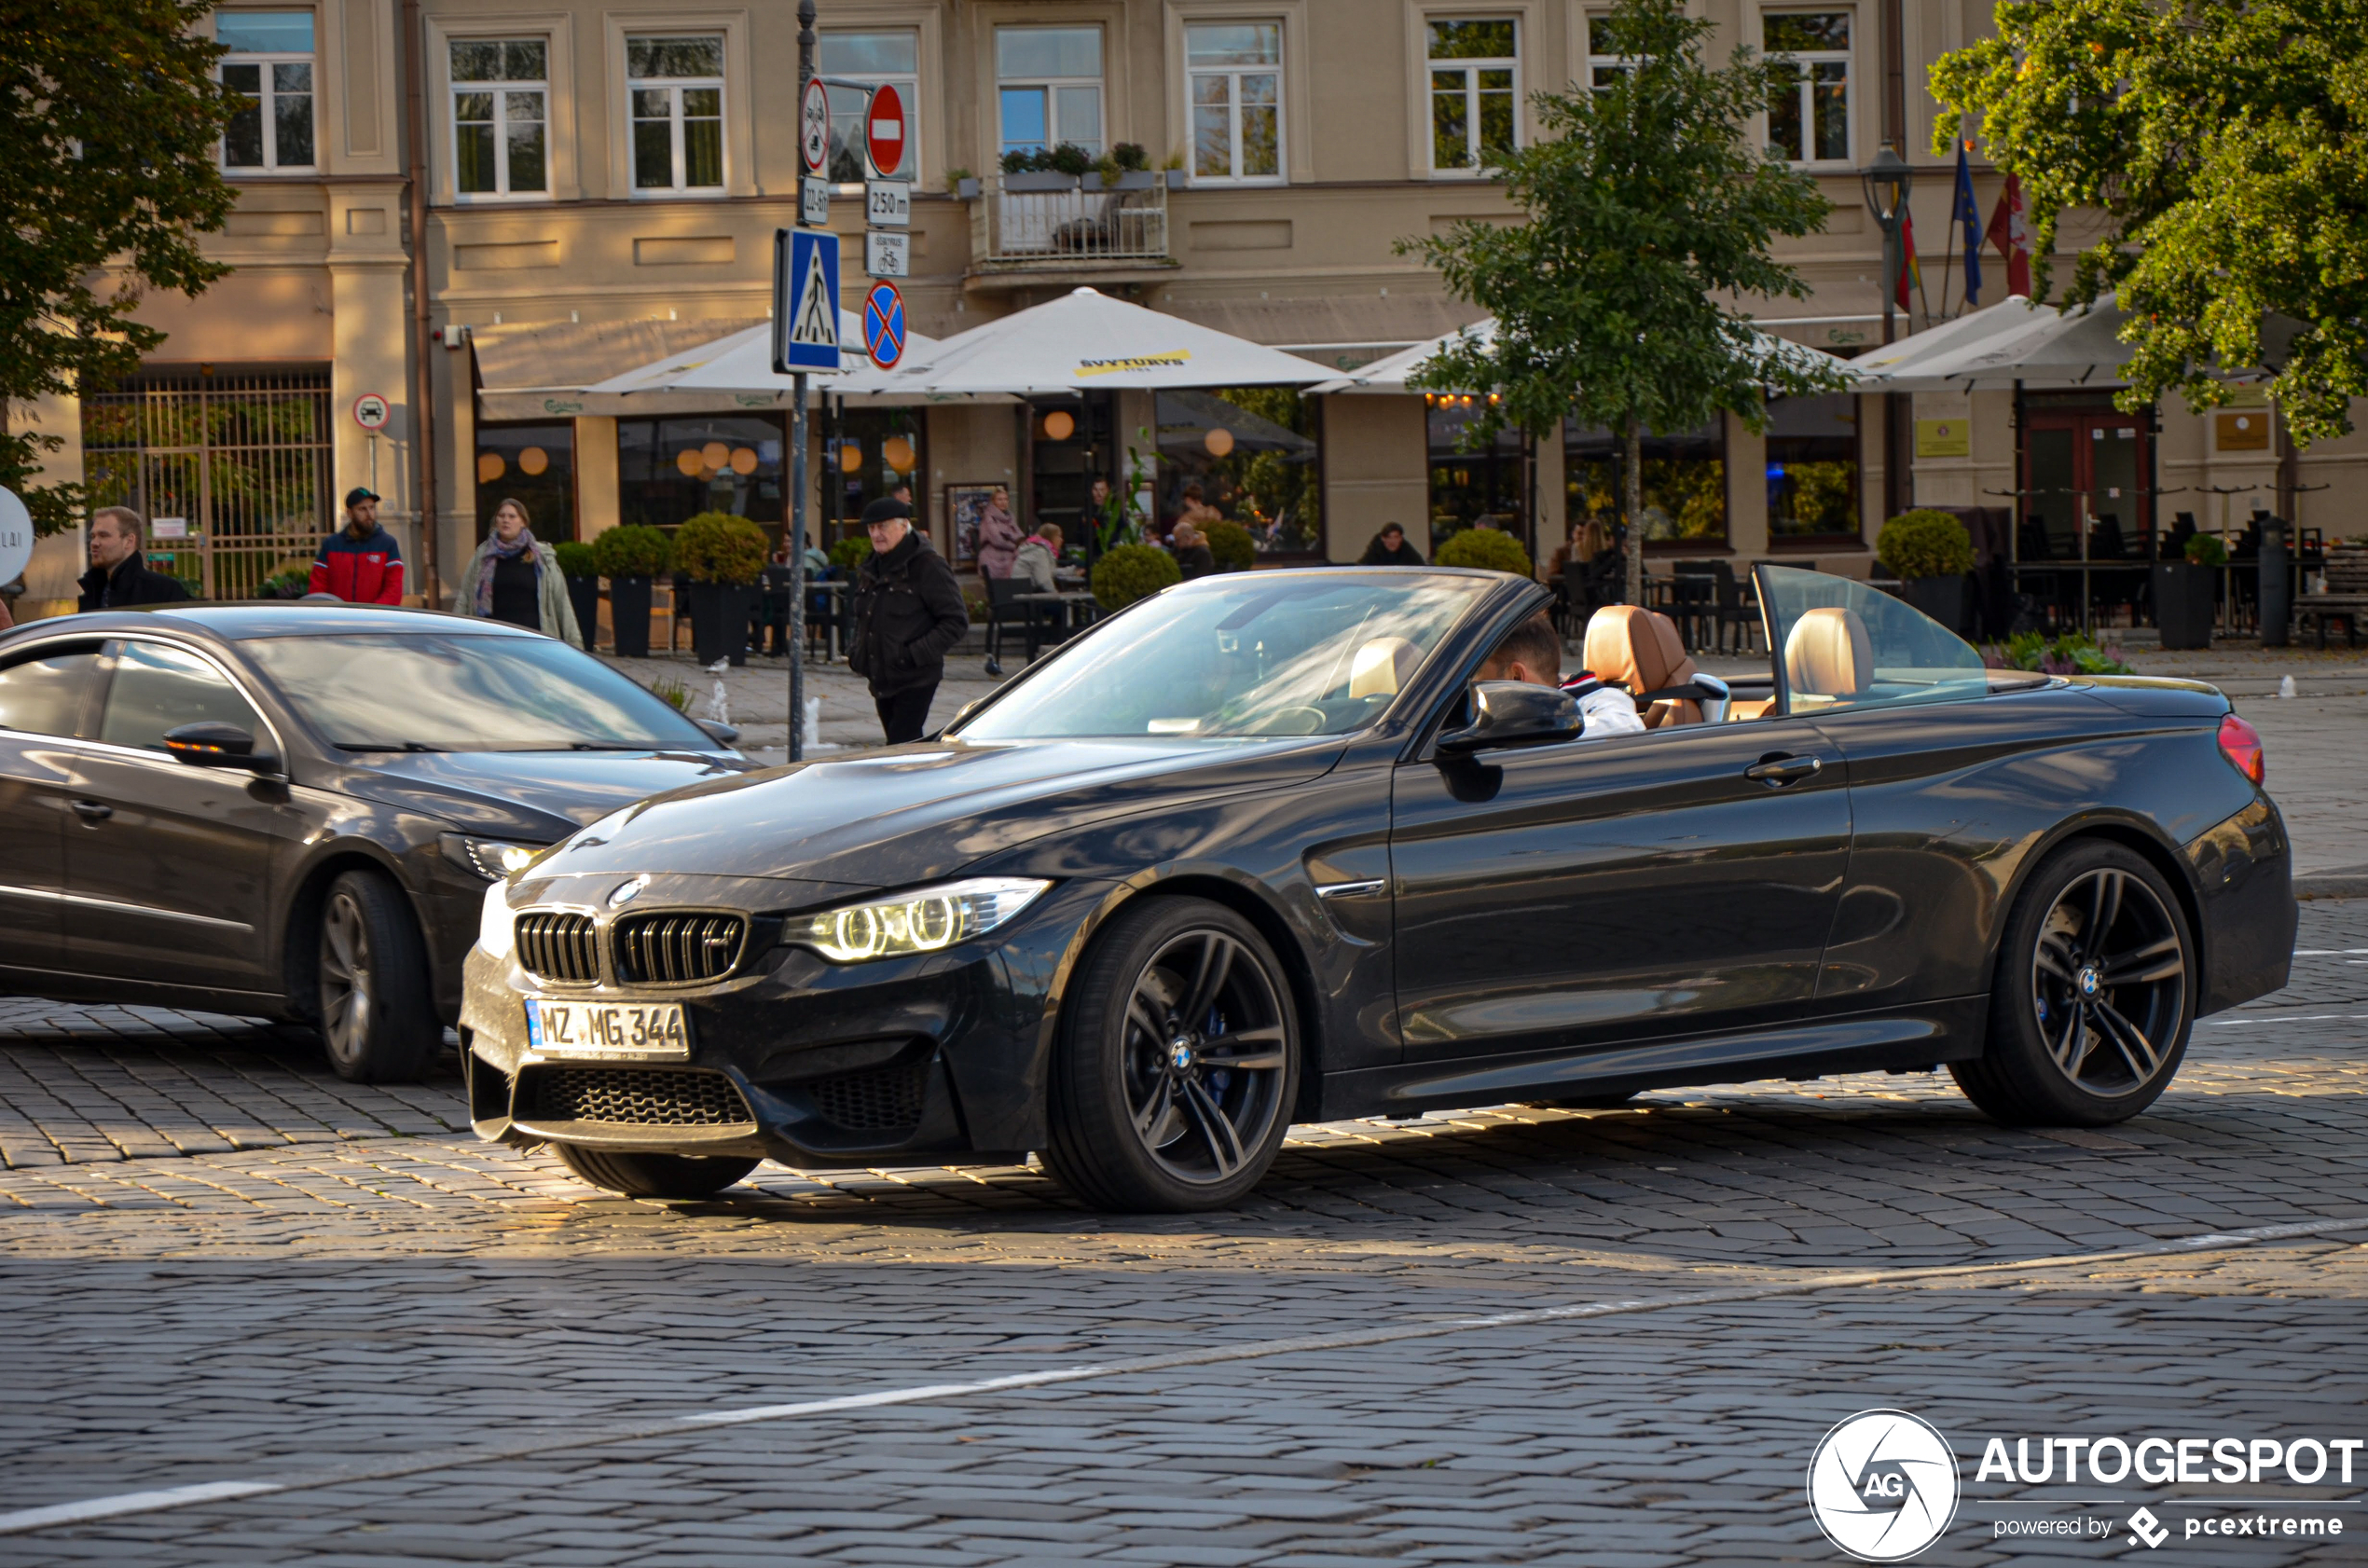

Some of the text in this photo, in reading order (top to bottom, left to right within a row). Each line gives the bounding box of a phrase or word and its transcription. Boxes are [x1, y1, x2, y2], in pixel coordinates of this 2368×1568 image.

[872, 192, 908, 214] 250 m
[541, 1007, 684, 1047] MZ MG 344
